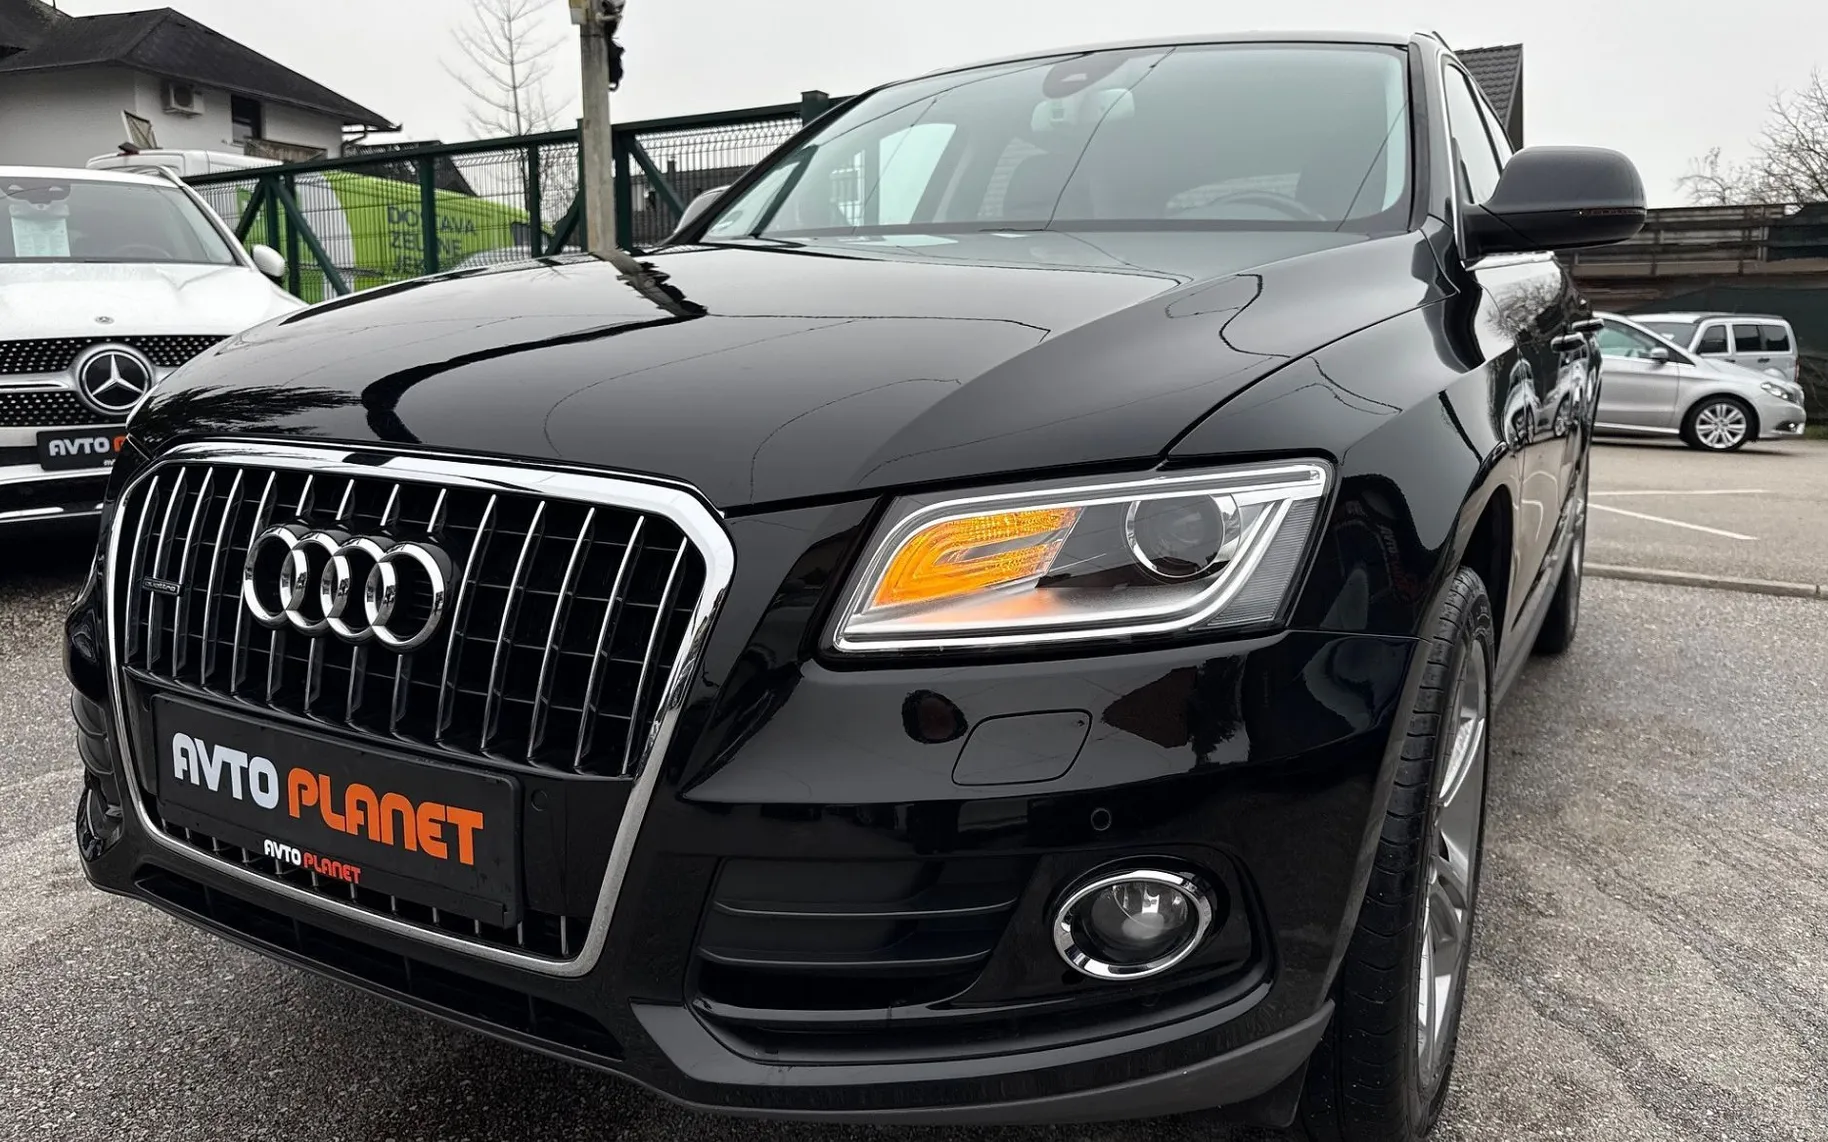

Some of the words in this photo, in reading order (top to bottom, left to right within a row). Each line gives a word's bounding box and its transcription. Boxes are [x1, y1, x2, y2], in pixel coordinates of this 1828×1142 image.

[387, 205, 476, 234] DOAVA
[391, 231, 462, 257] ZELNE
[49, 436, 110, 456] AVTO
[172, 732, 280, 810] AVTO
[287, 767, 484, 866] PLANET
[264, 838, 302, 866] AVTO
[303, 852, 361, 884] PLANET
